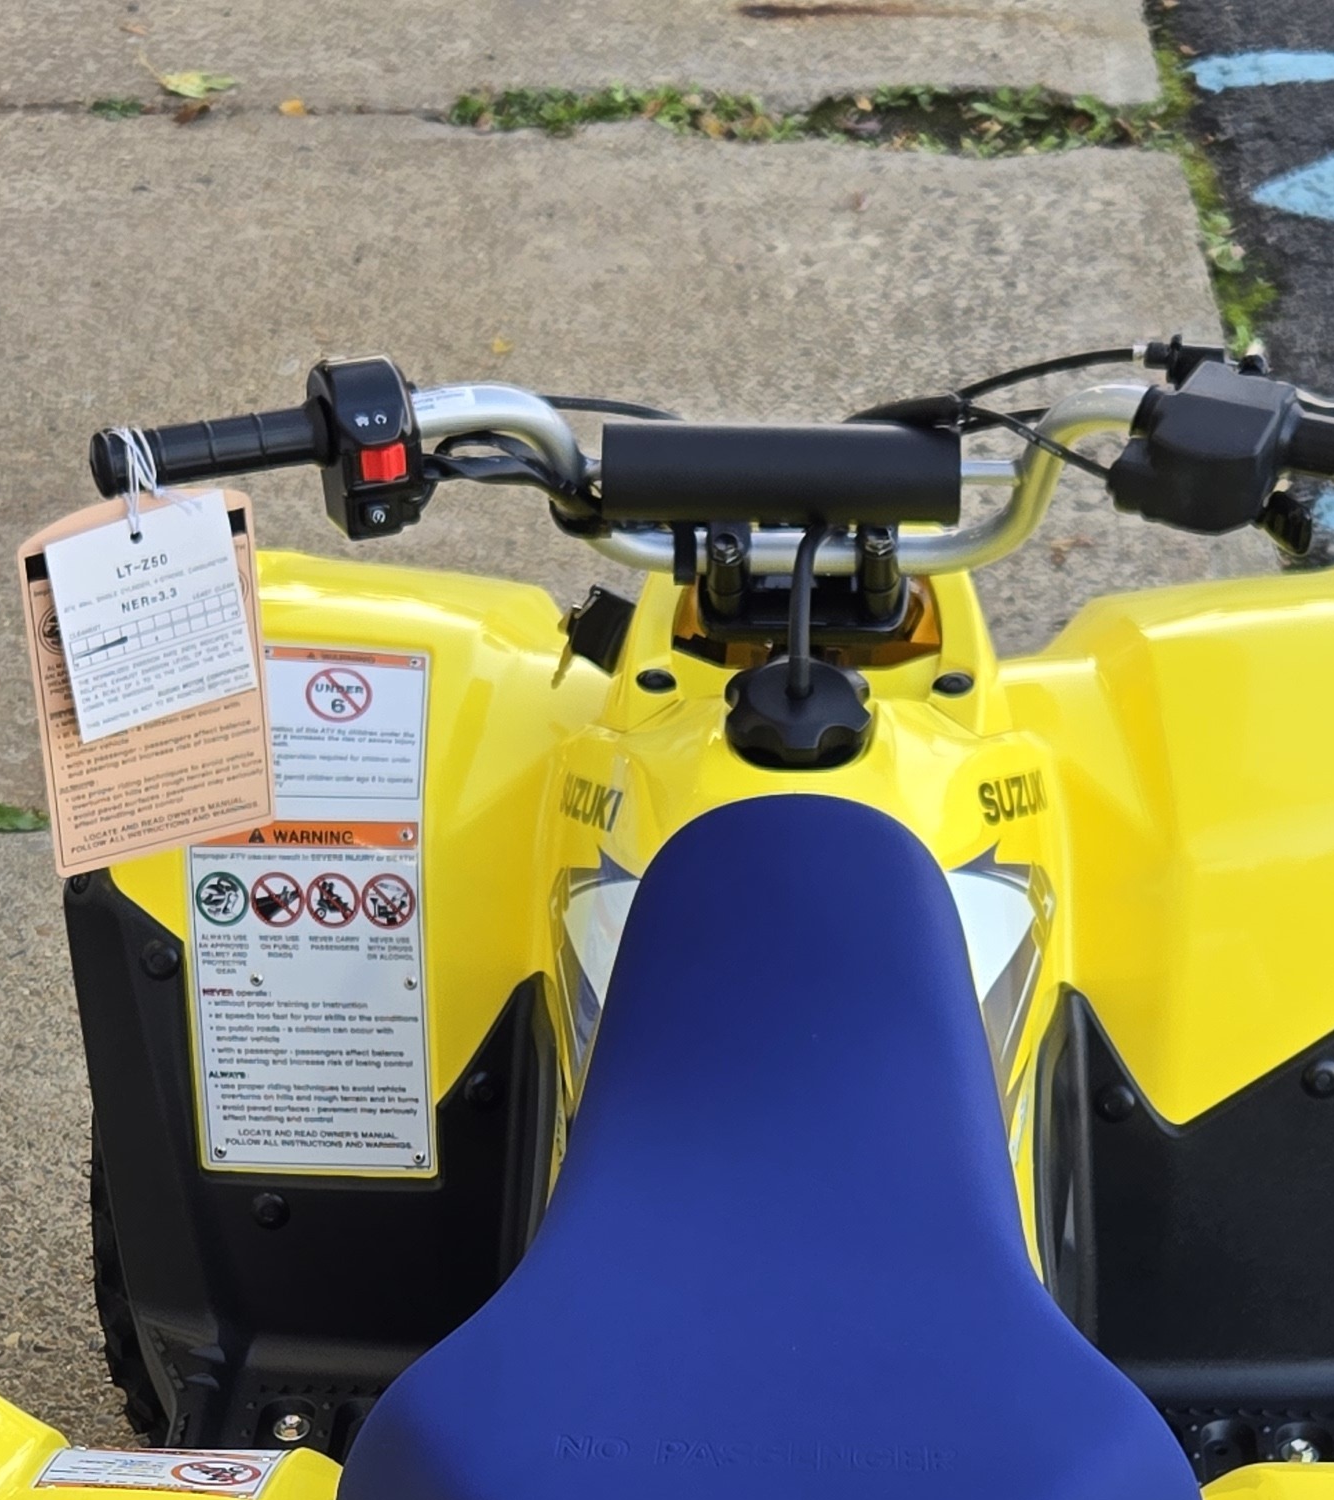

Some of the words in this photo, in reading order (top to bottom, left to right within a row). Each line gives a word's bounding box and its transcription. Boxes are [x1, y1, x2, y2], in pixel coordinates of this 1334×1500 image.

[116, 553, 169, 579] LT-Z50
[121, 587, 179, 614] NER=3.3
[315, 683, 364, 695] UNDER
[331, 698, 346, 714] 6
[978, 767, 1048, 826] SUZUKI
[273, 829, 355, 845] WARNING
[553, 1434, 632, 1464] NO
